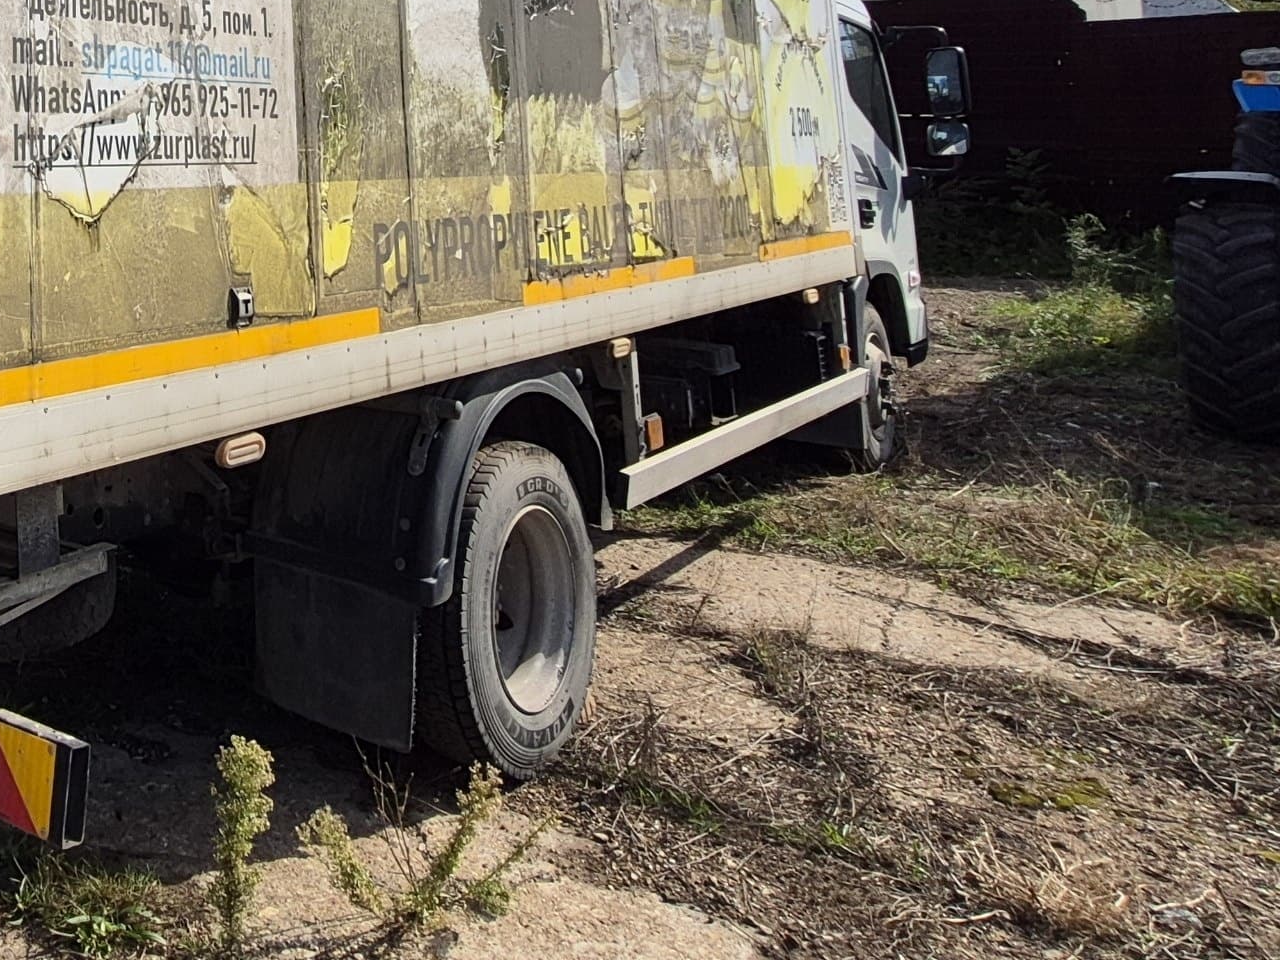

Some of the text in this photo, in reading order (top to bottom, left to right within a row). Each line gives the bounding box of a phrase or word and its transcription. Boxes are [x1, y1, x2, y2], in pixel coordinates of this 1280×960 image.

[202, 0, 217, 37] 5,
[222, 9, 257, 38] пом.
[261, 7, 273, 38] 1.
[81, 39, 271, 82] shpagat.116@mail.ru
[200, 85, 279, 119] 925-11-72
[796, 106, 812, 137] 500
